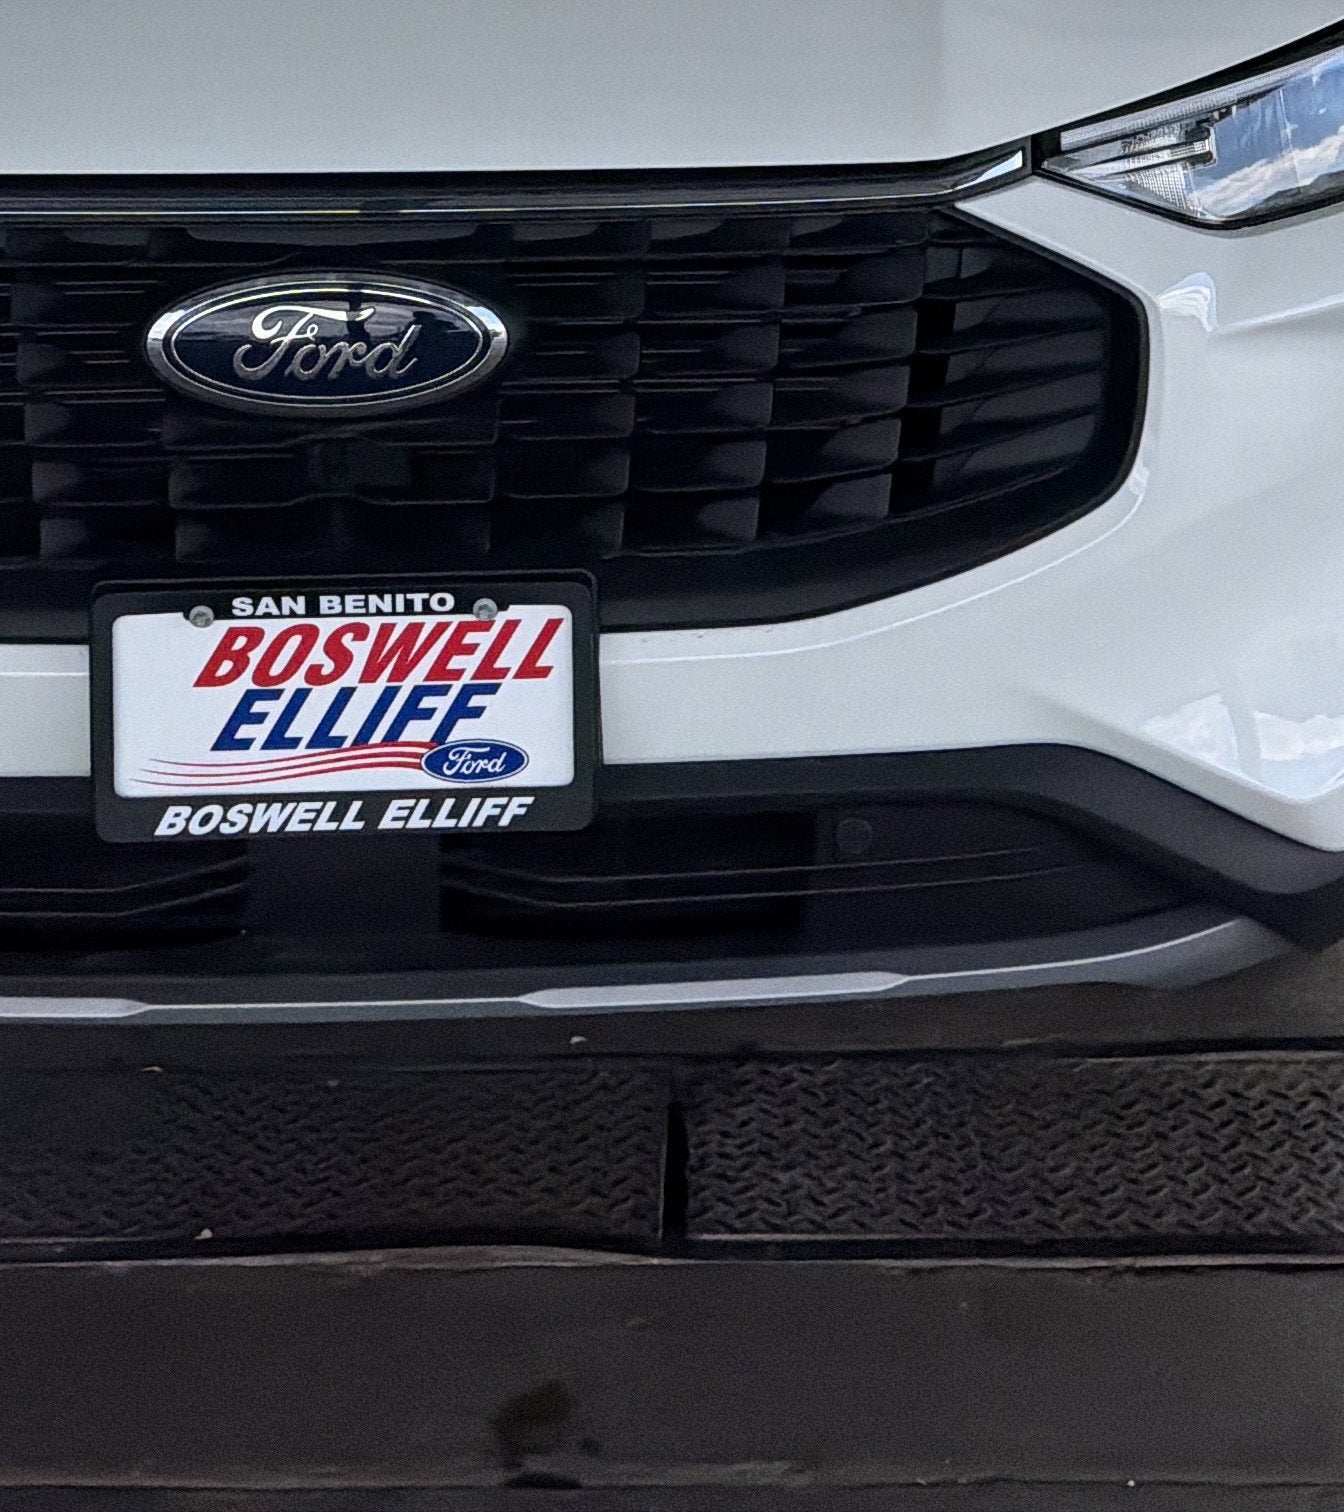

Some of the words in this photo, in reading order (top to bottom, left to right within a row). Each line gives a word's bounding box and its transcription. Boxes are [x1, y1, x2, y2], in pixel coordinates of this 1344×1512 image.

[232, 305, 423, 380] Ford
[231, 596, 306, 616] SAN
[320, 592, 455, 615] BENITO
[193, 618, 564, 687] BOSWELL
[210, 683, 503, 751] ELLIFF
[442, 746, 506, 776] Ford
[154, 800, 366, 836] BOSWELL
[378, 796, 535, 830] ELLIFF
